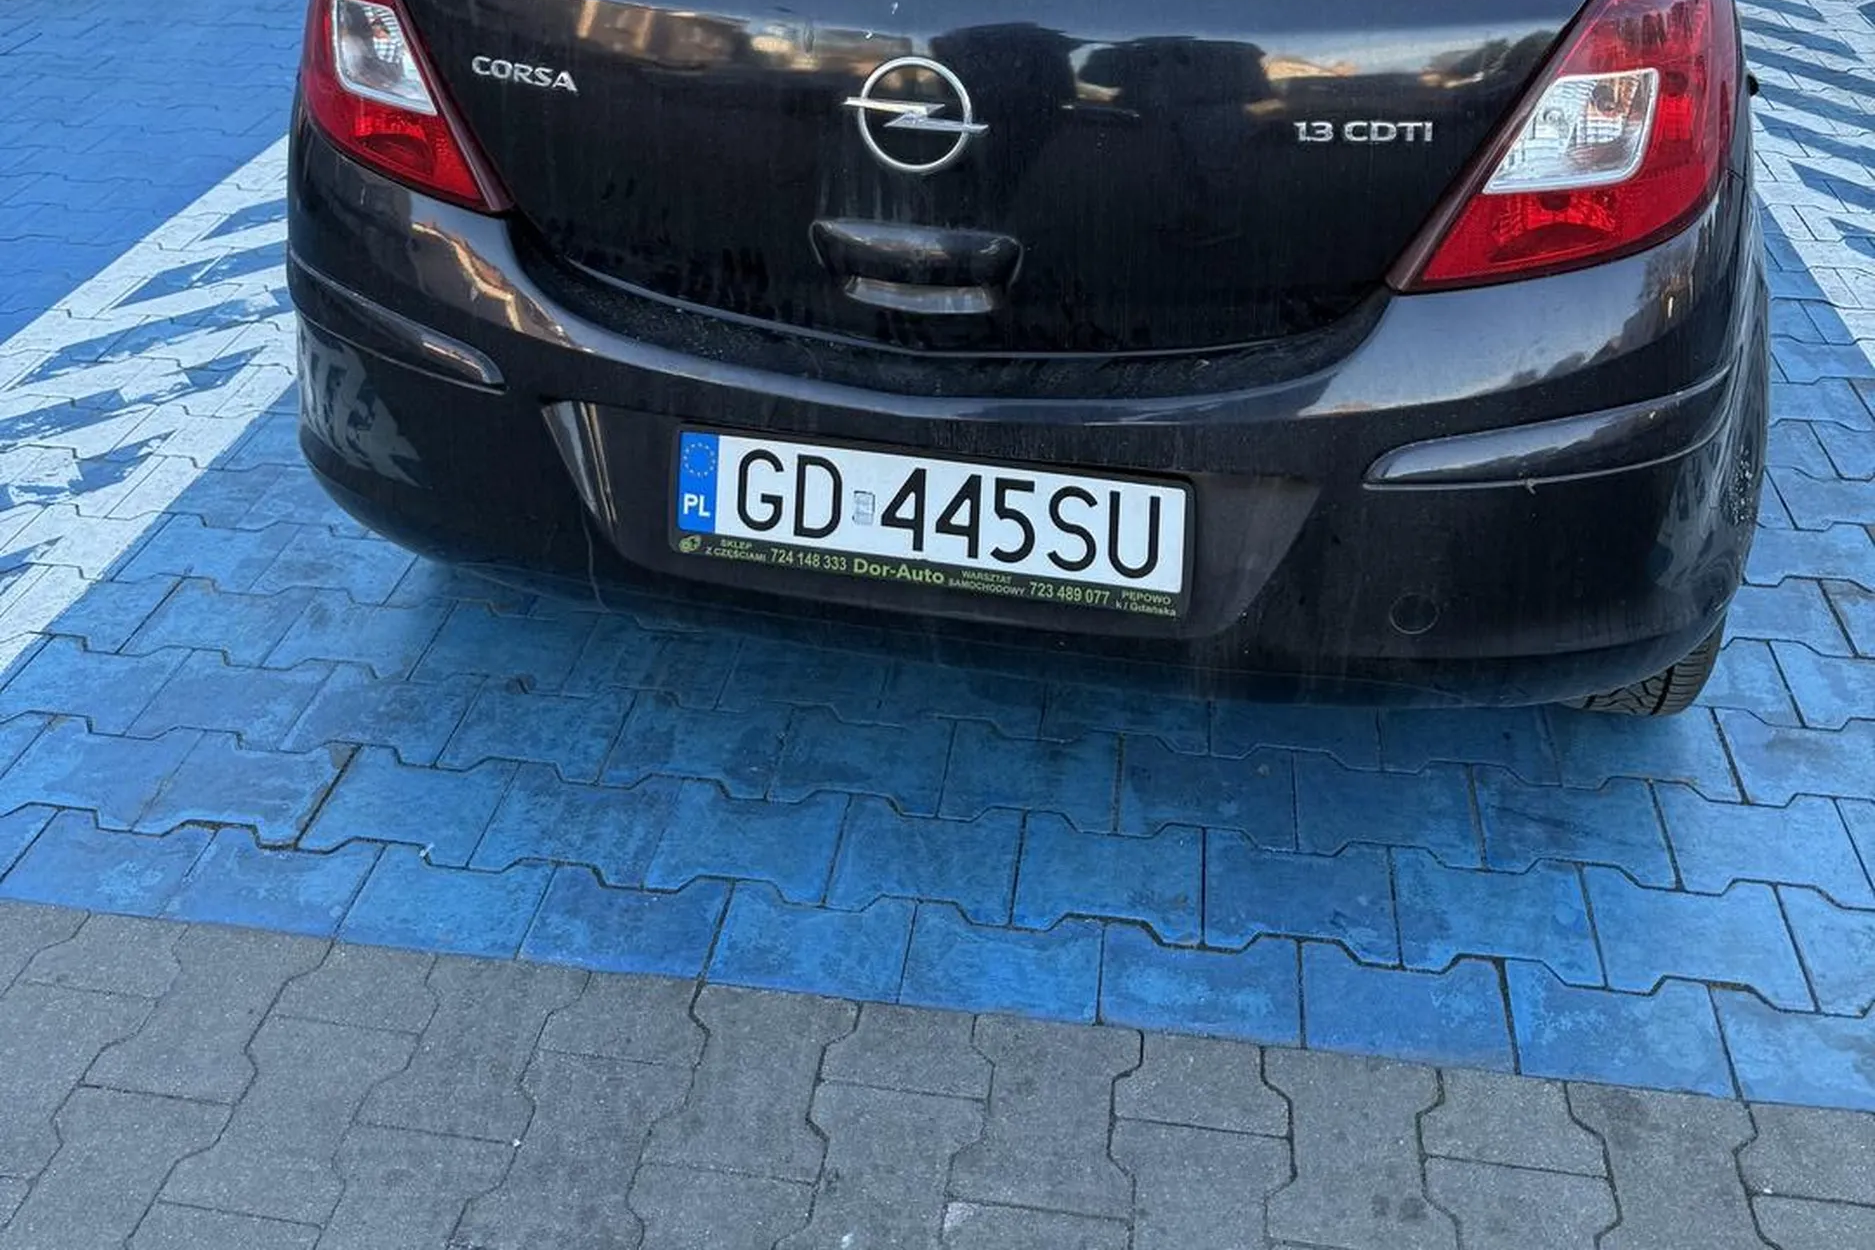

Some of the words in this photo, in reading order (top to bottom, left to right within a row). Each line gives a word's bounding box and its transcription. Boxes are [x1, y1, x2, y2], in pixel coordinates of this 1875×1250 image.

[472, 56, 578, 92] CORSA
[1344, 121, 1433, 143] CDTI
[683, 493, 711, 517] PL
[737, 449, 842, 539] GD
[880, 467, 1162, 579] 445SU
[720, 539, 752, 550] SKLEP
[770, 548, 793, 564] 724
[799, 553, 820, 568] 148
[823, 555, 847, 571] 333
[853, 558, 945, 584] Dor-Auto
[961, 570, 1012, 584] WARSZTAT
[1029, 582, 1053, 598] 723
[1057, 586, 1081, 602] 489
[1085, 588, 1110, 605] 077
